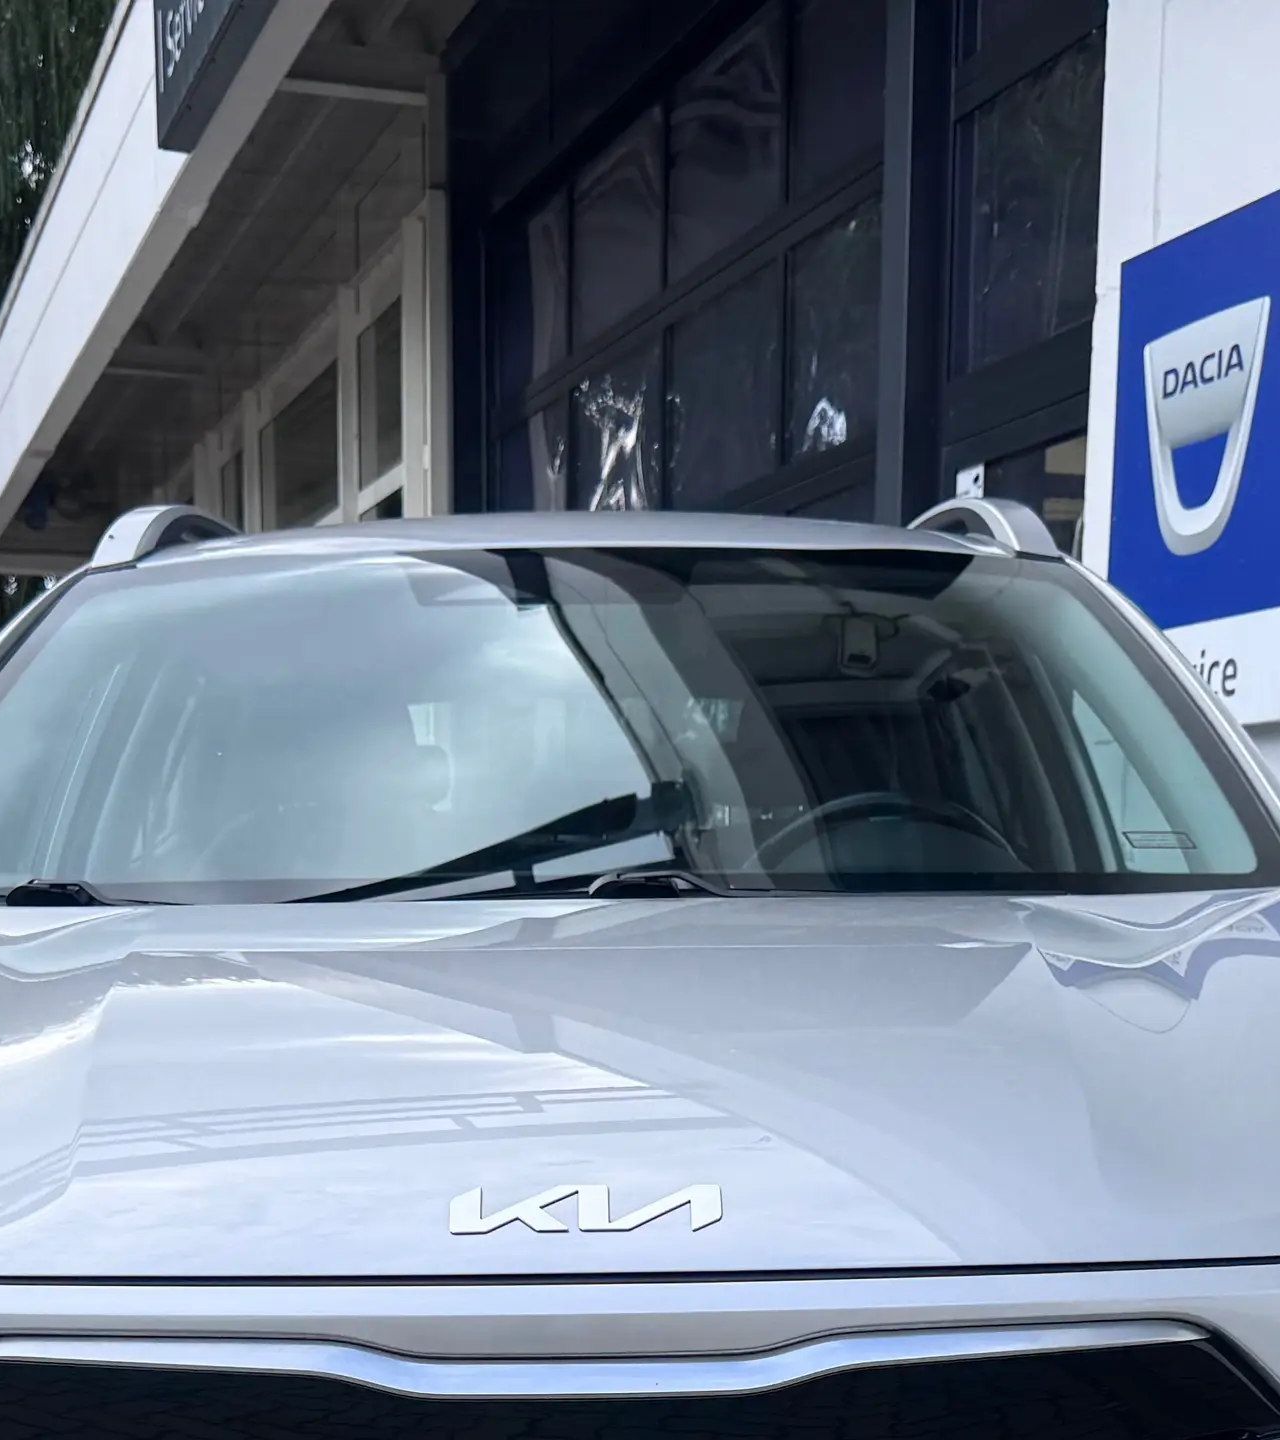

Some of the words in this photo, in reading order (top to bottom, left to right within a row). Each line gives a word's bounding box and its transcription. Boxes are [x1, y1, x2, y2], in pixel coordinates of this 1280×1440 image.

[1162, 344, 1244, 399] DACIA
[1193, 649, 1238, 697] ice
[449, 1184, 723, 1235] KIA
